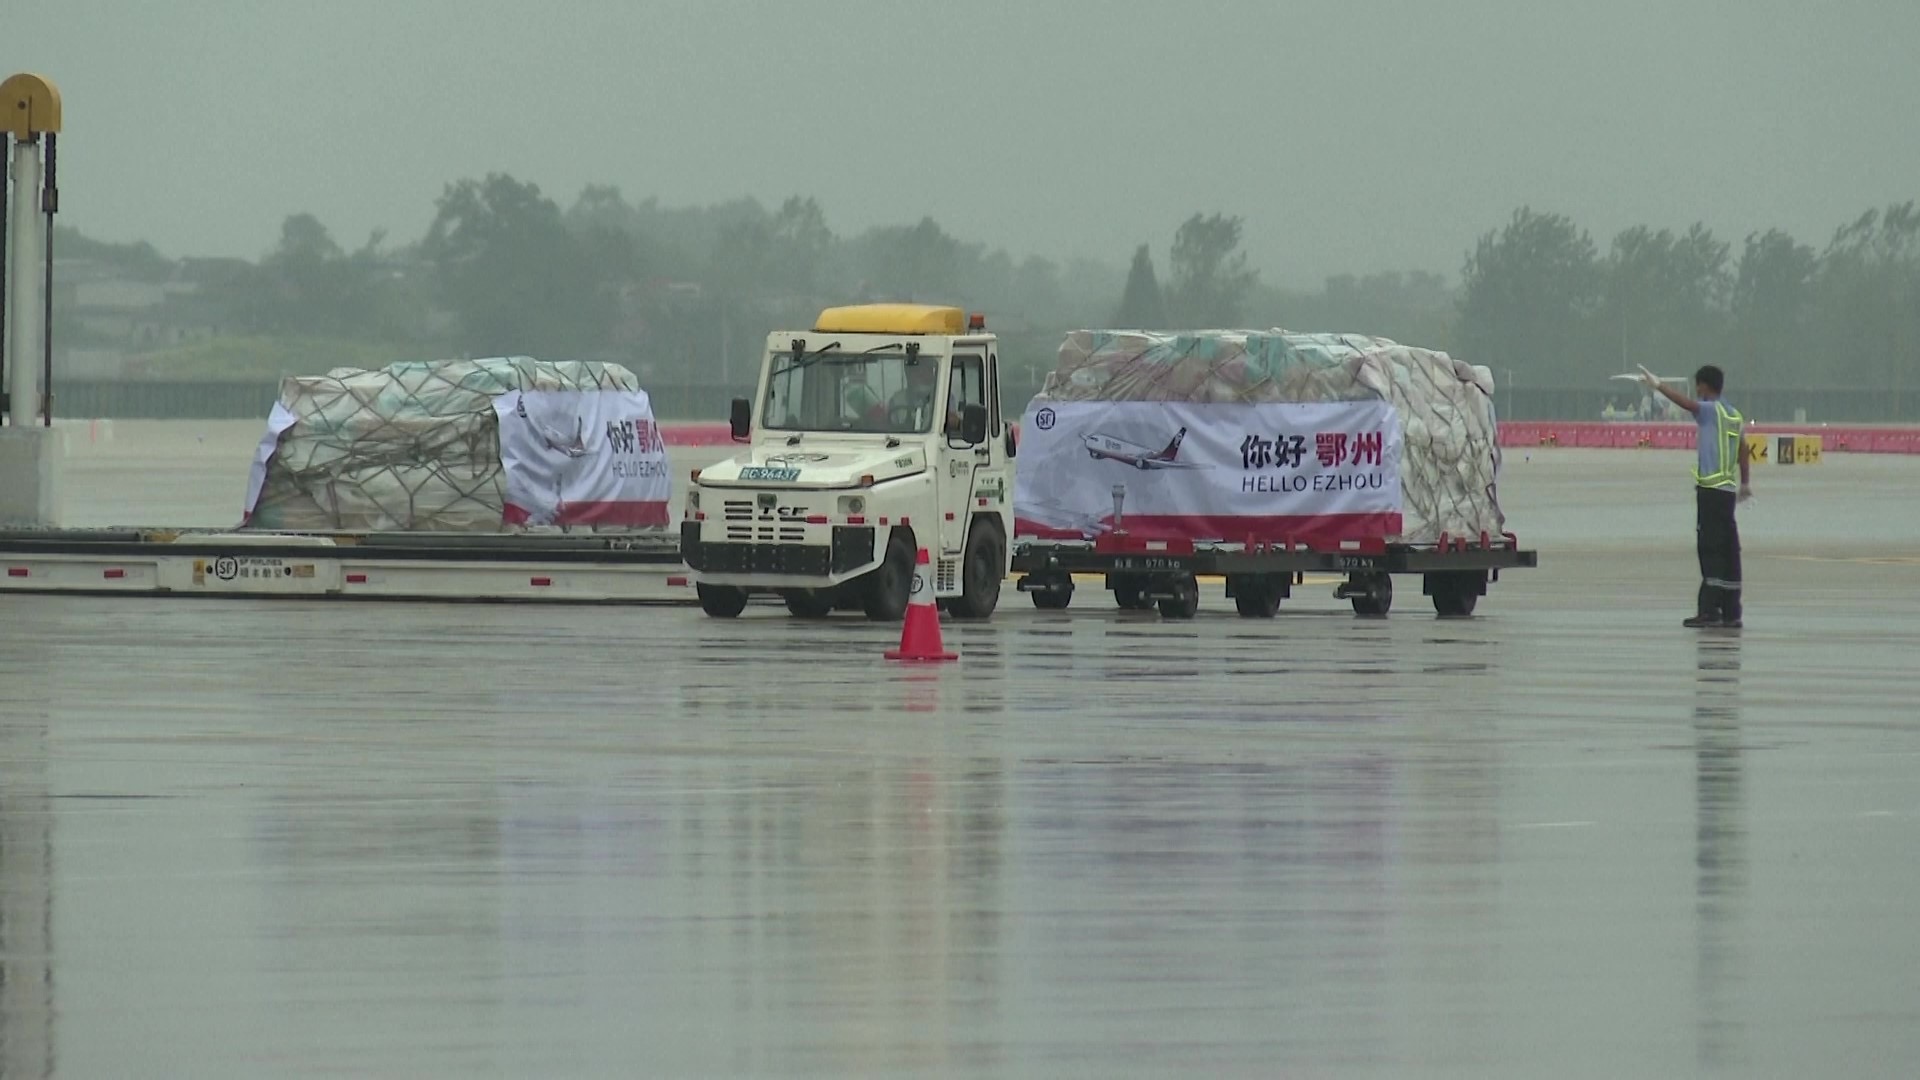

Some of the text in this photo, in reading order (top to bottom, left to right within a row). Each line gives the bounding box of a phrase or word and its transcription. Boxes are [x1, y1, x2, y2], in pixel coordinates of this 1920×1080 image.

[1240, 431, 1382, 469] 你好 鄂州
[1242, 473, 1383, 492] HELLO EZHOU
